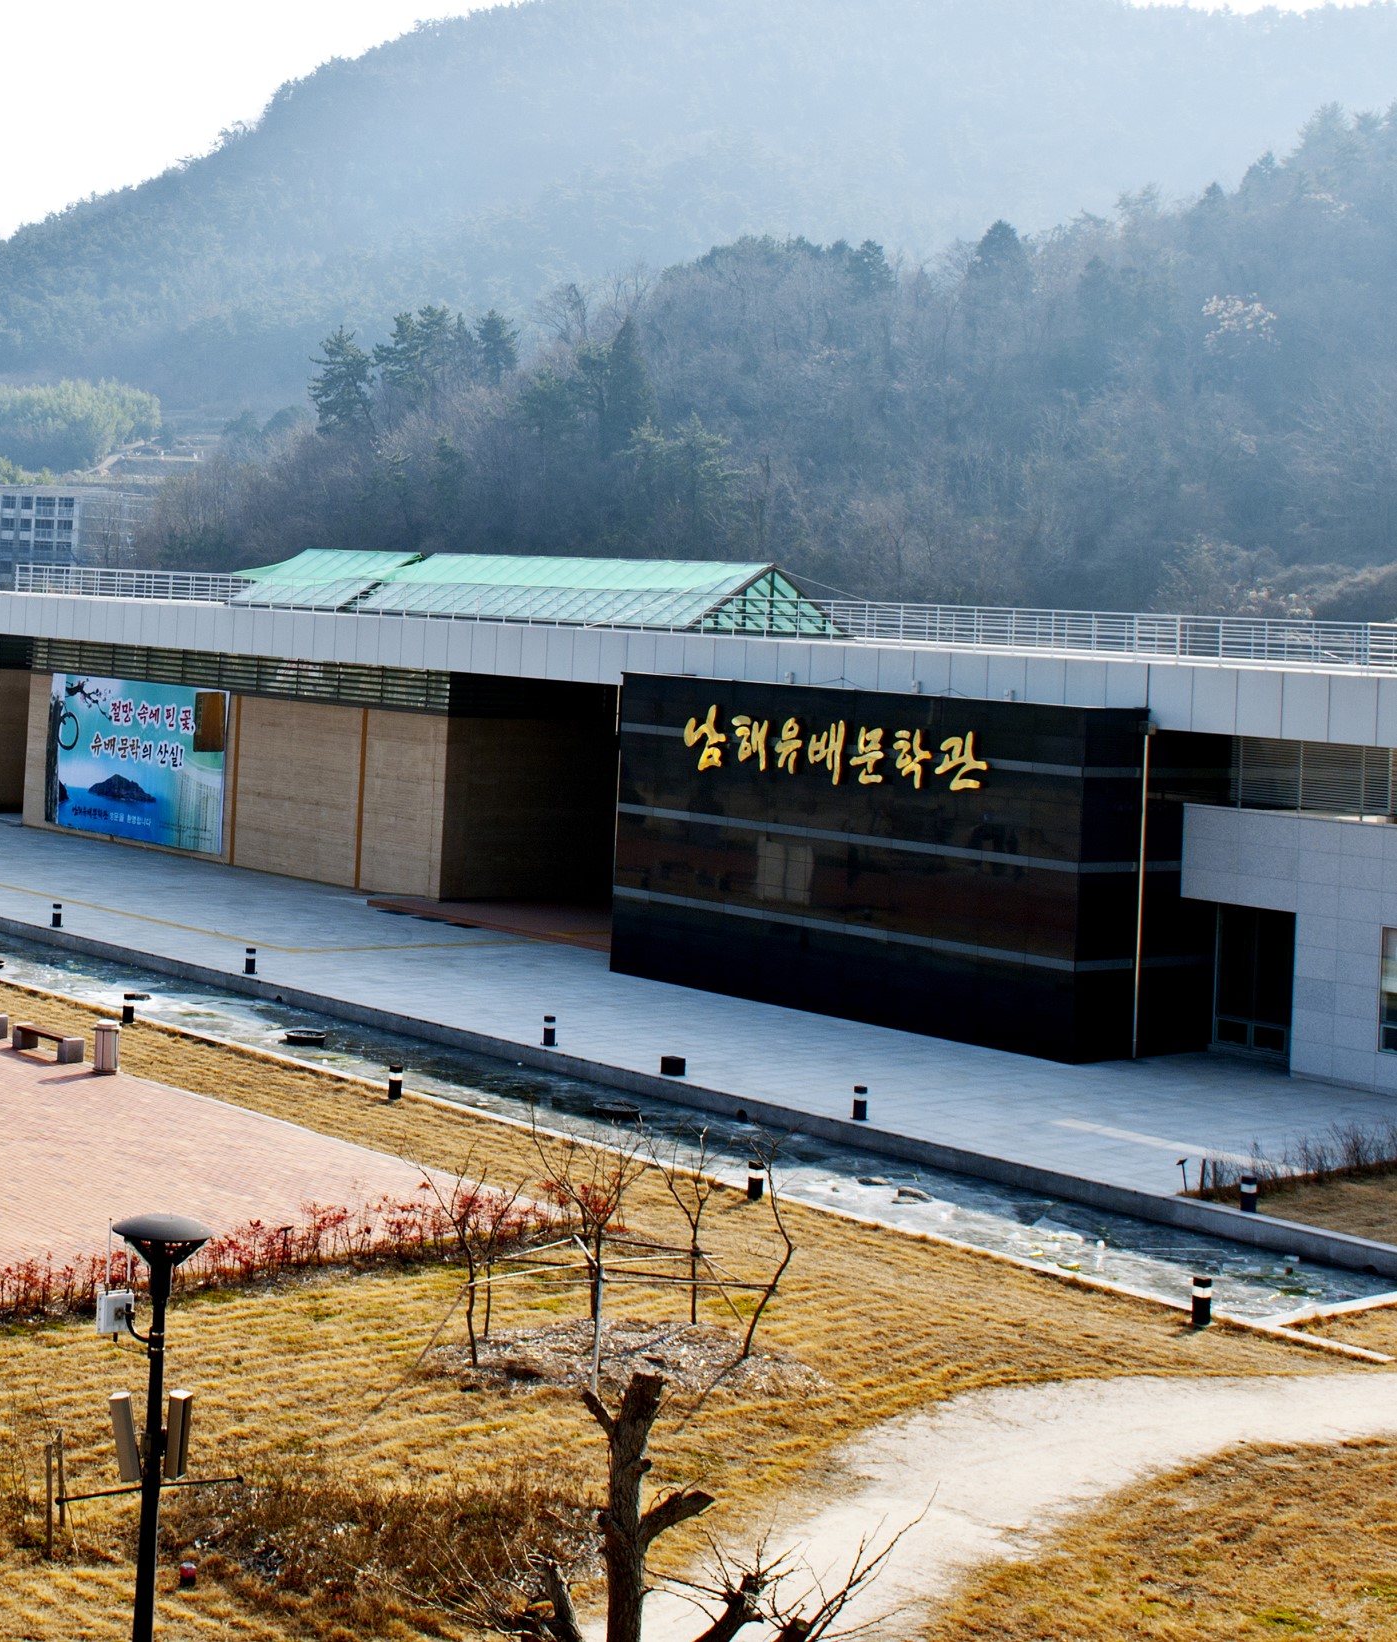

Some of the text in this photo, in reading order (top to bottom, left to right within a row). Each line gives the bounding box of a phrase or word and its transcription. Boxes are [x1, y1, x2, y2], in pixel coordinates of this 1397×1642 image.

[111, 700, 133, 724] 절망
[137, 704, 160, 725] 속에
[165, 706, 175, 728] 핀
[180, 709, 194, 731] 꽃,
[91, 733, 183, 767] 유배문학의 산실!
[683, 704, 988, 791] 남해유배문학관
